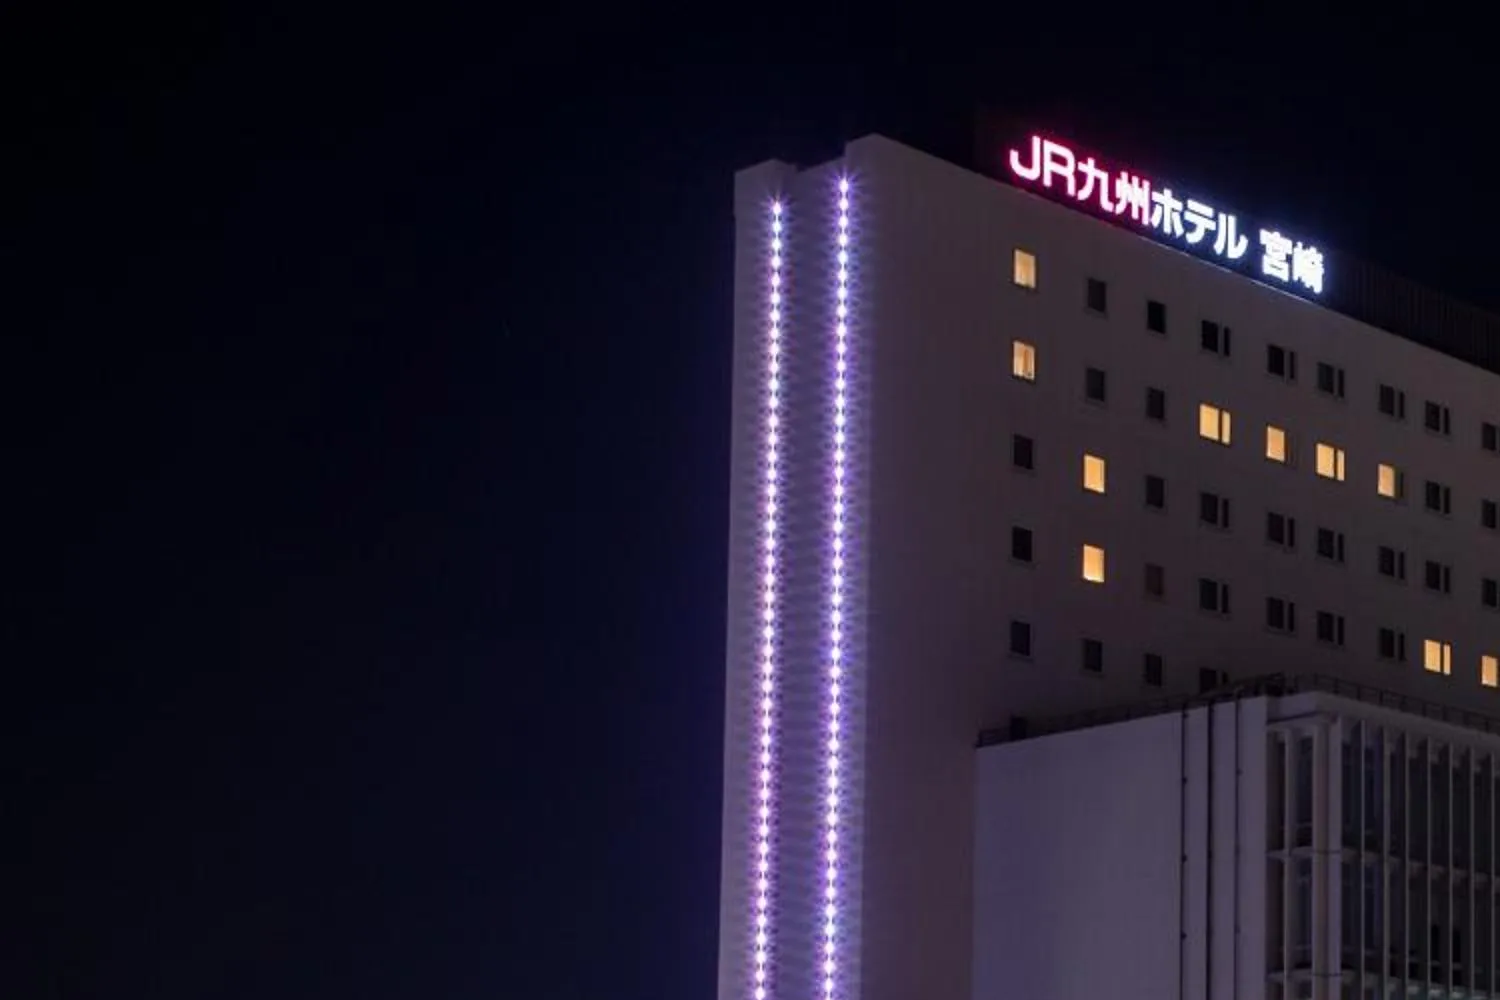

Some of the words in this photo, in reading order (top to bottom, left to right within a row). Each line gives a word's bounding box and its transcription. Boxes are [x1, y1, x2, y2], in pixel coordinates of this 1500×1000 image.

[1009, 135, 1249, 260] JR九州ホテル
